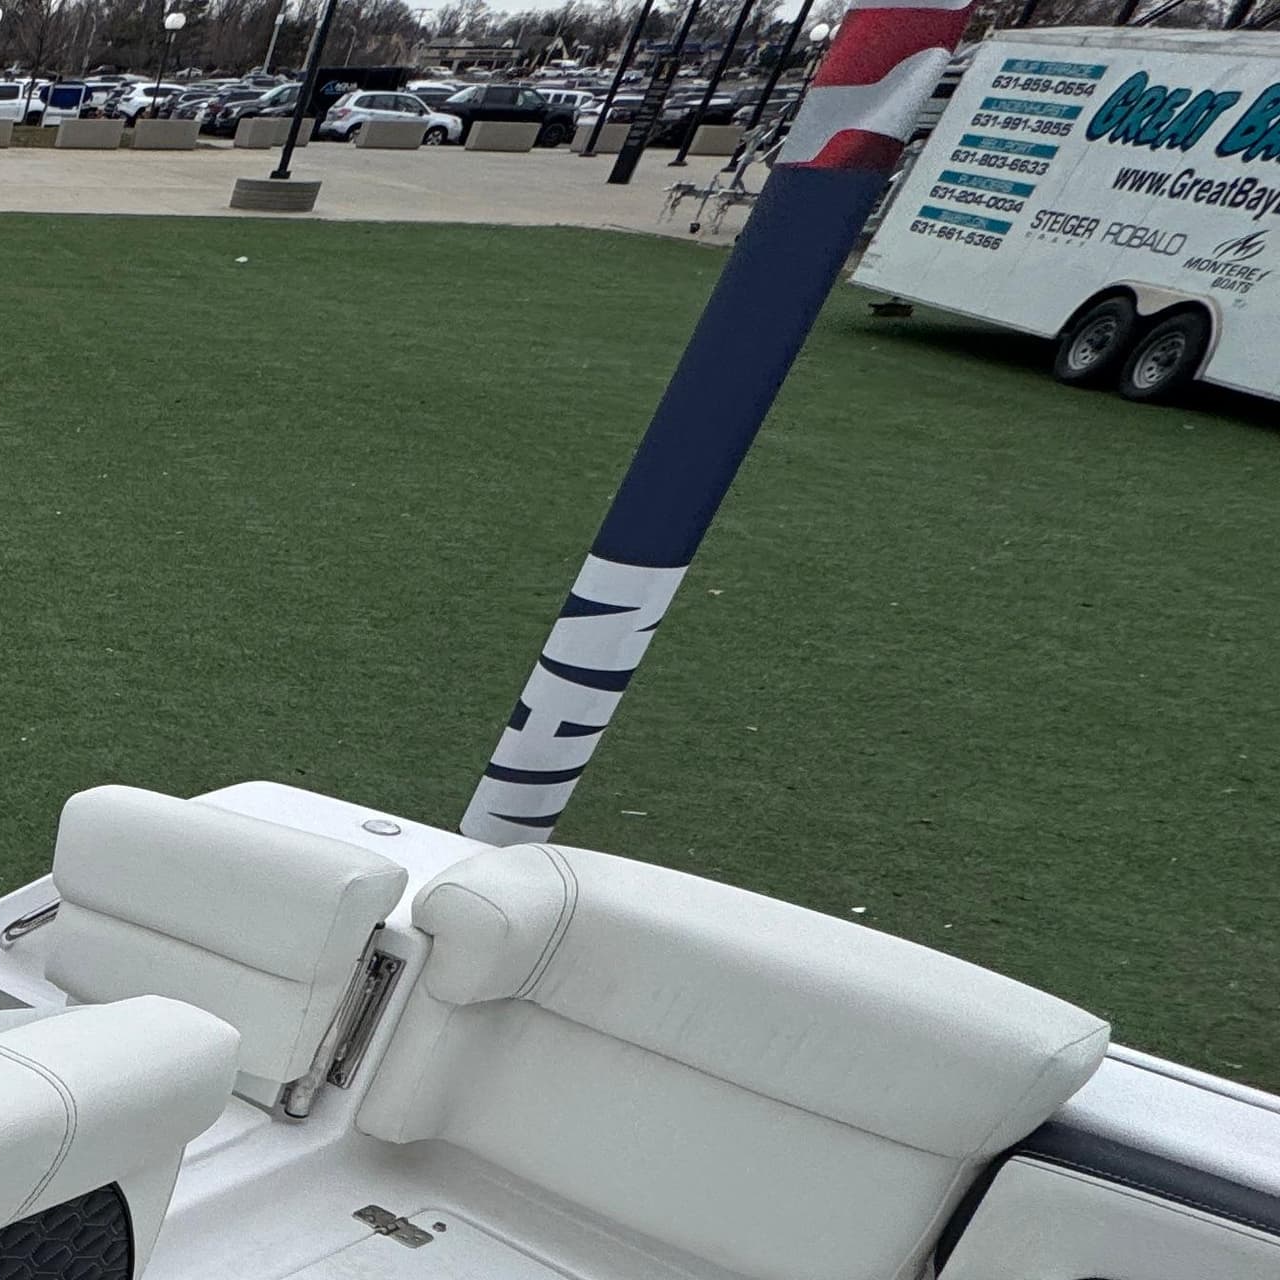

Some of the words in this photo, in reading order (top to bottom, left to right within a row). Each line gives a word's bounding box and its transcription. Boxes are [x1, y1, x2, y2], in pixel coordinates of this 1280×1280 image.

[992, 75, 1097, 97] 631-859-0654
[1086, 71, 1243, 152] GREAT
[1030, 209, 1101, 239] STEIGER
[1101, 222, 1188, 256] ROBALO
[1183, 256, 1273, 282] MONTEREY
[1211, 277, 1255, 294] BOATS
